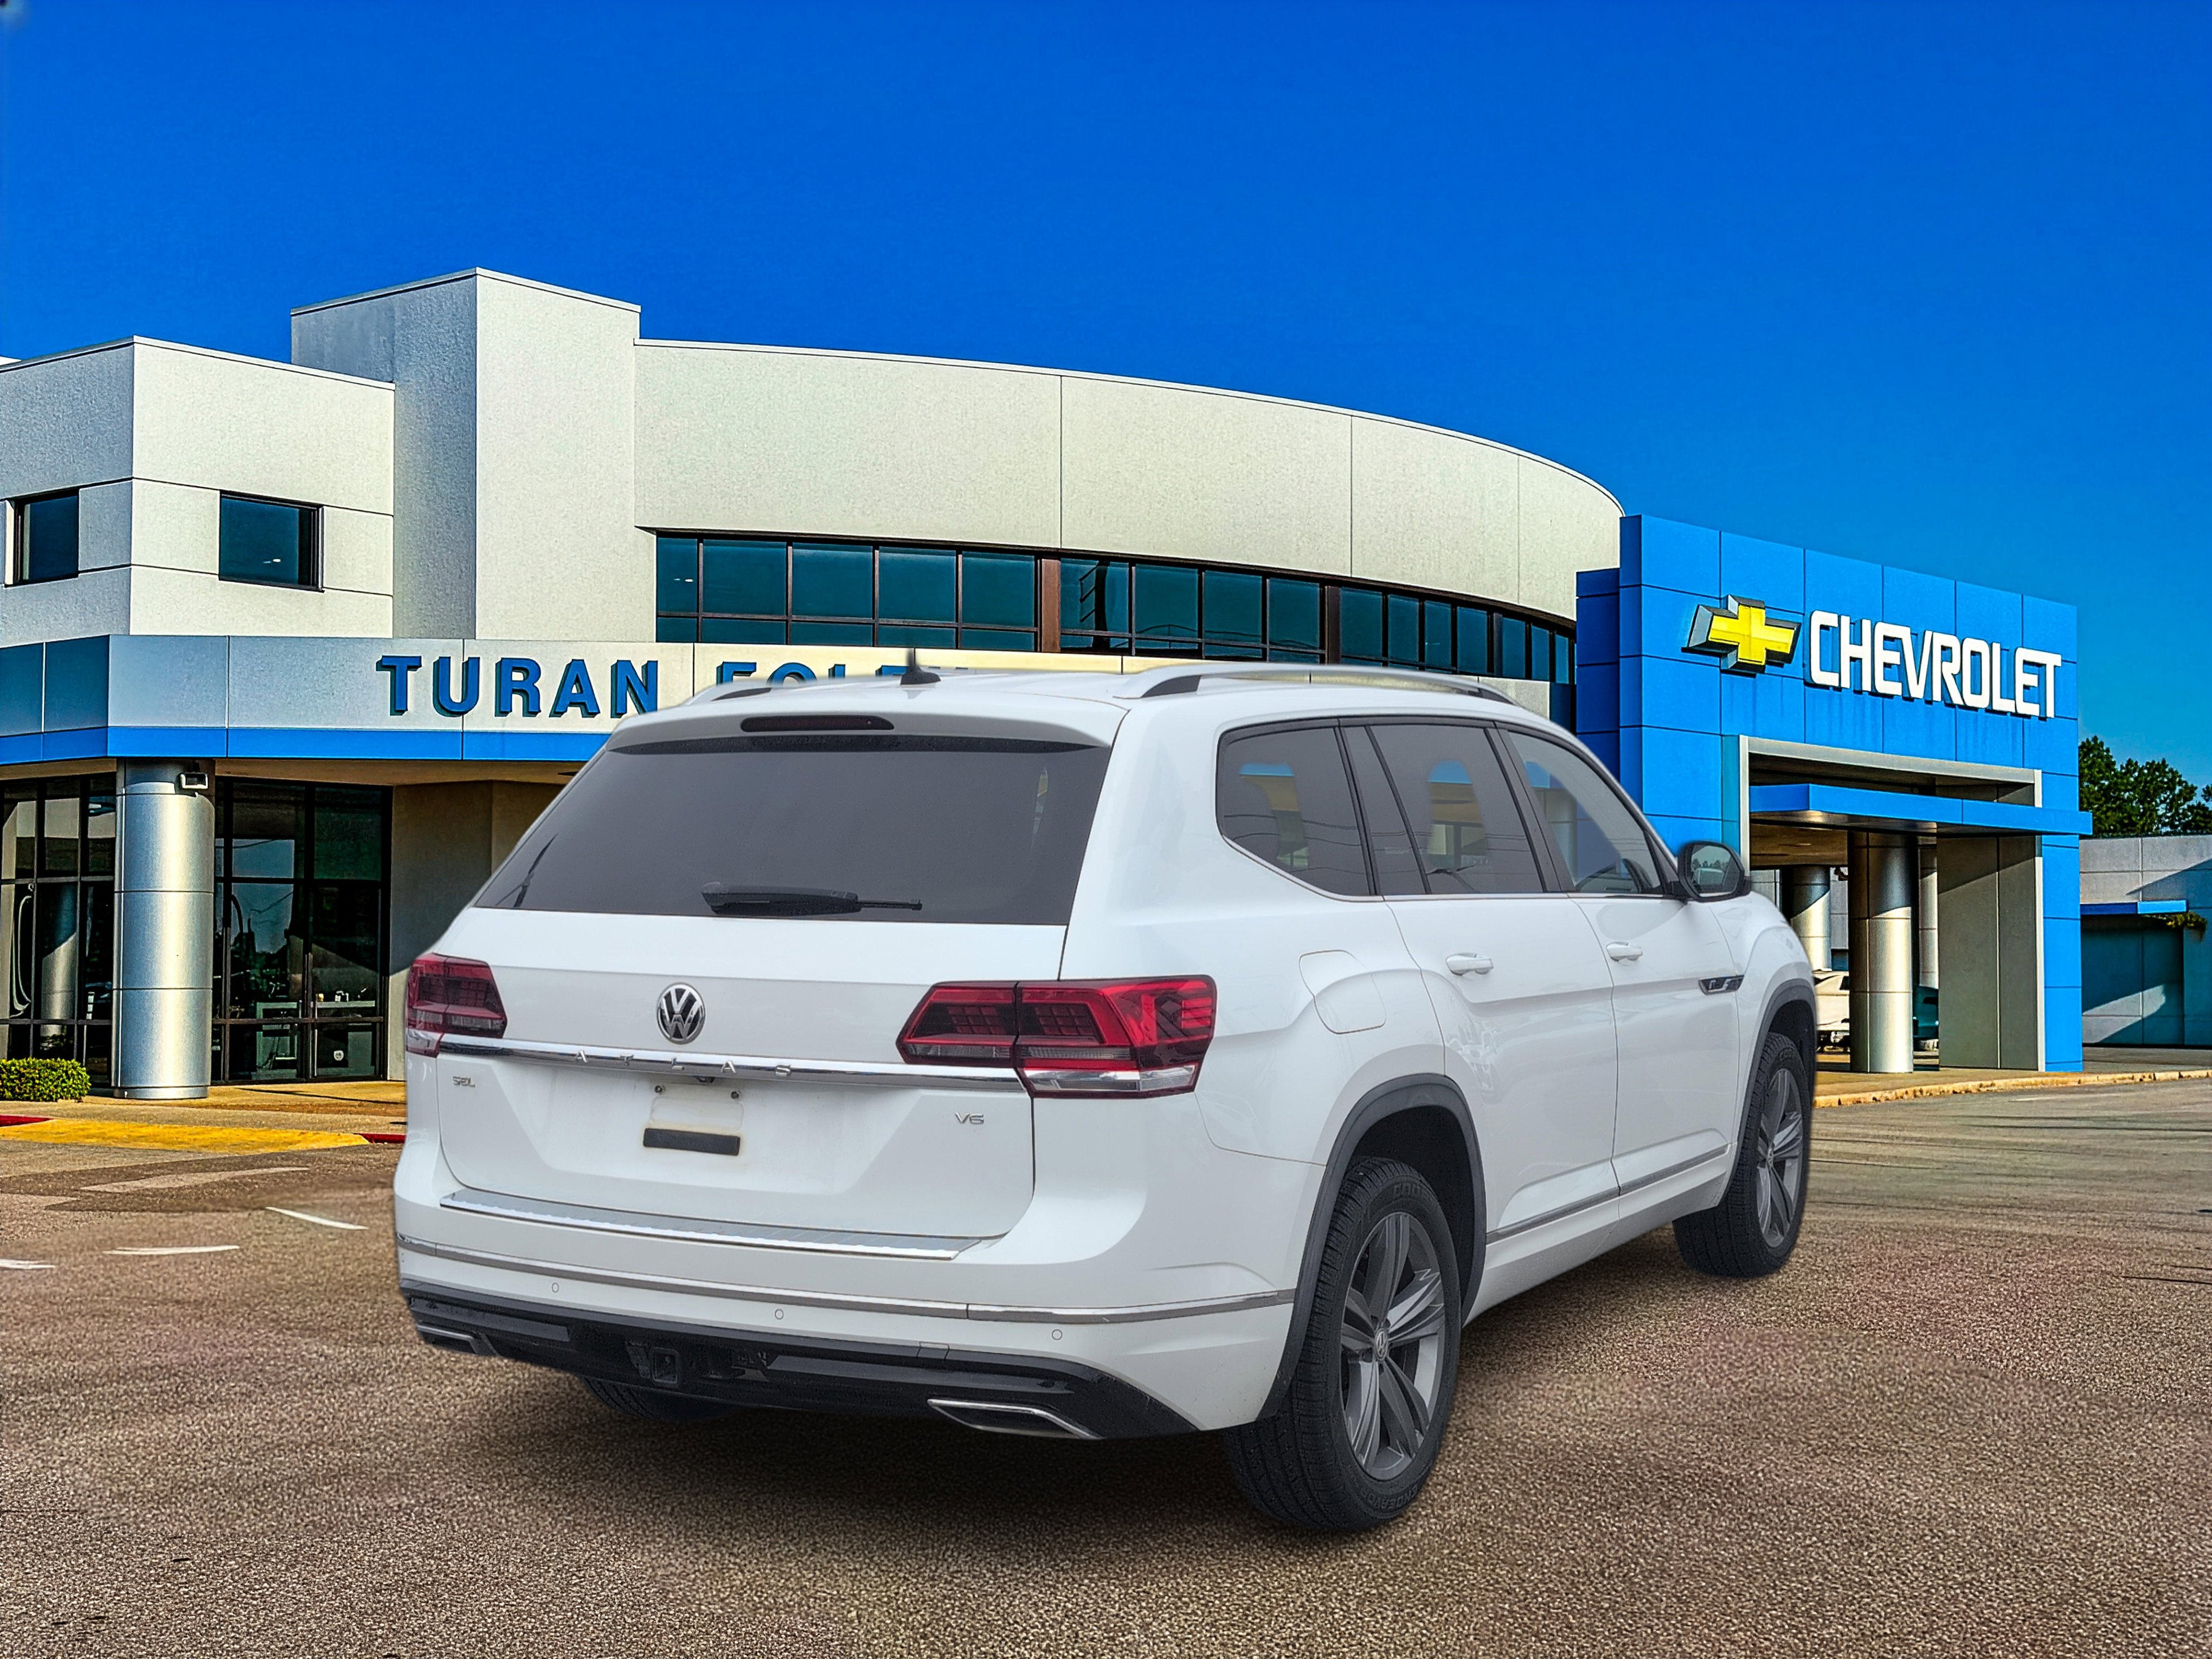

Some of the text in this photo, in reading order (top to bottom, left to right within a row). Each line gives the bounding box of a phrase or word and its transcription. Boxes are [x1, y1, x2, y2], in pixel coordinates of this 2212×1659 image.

[376, 655, 659, 718] TURAN
[1810, 610, 2062, 718] CHEVROLET
[657, 982, 705, 1045] VW
[452, 1076, 476, 1088] SEL
[574, 1049, 792, 1077] ATLAS
[955, 1113, 985, 1124] V6
